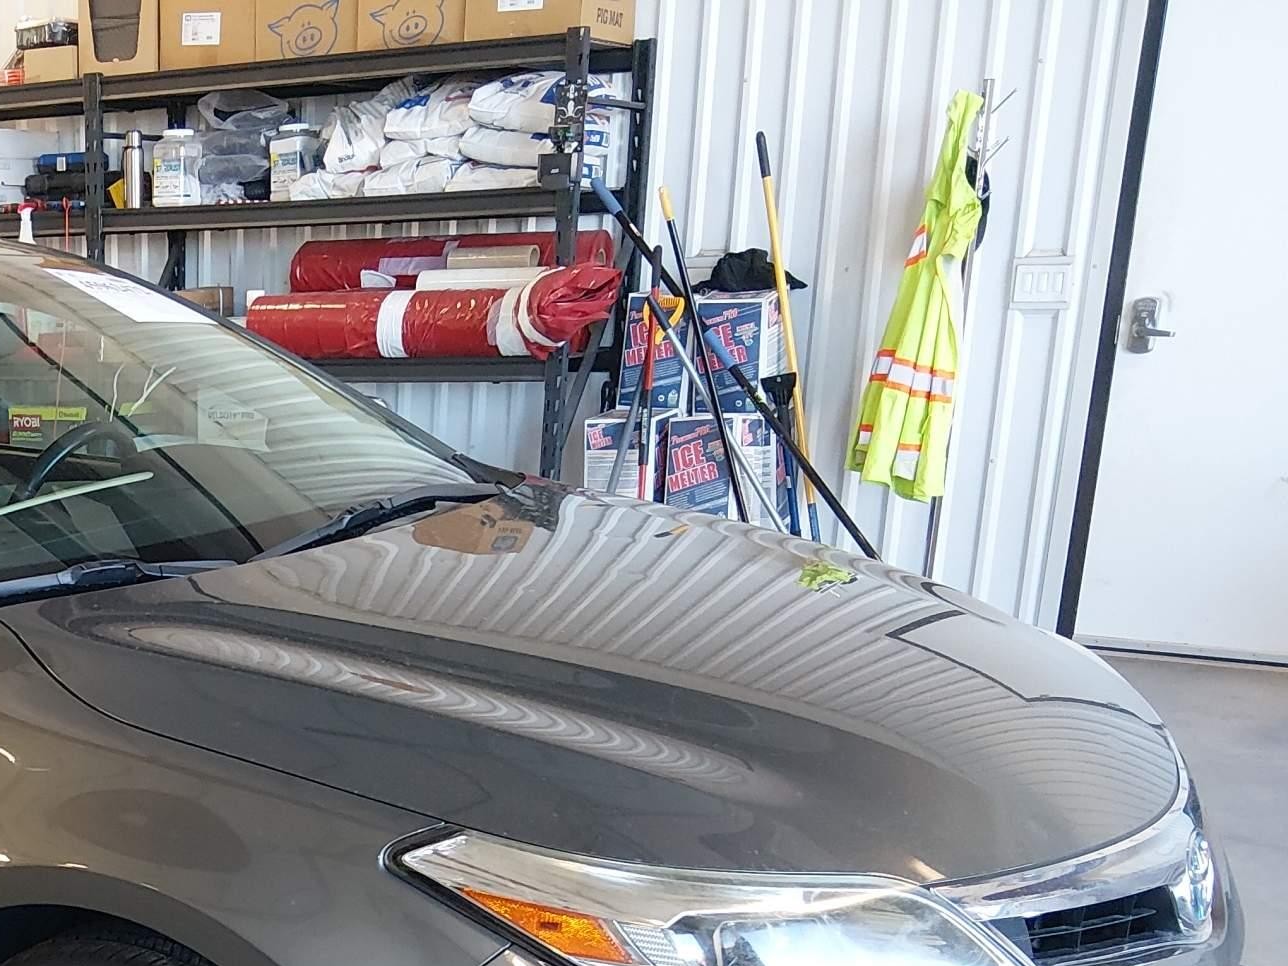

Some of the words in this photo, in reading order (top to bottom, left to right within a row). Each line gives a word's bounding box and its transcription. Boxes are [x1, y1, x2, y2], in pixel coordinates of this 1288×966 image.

[596, 7, 608, 25] PIG
[609, 9, 624, 28] MAT
[12, 416, 40, 429] RYOBI
[672, 439, 707, 474] ICE
[667, 462, 719, 493] MELTER
